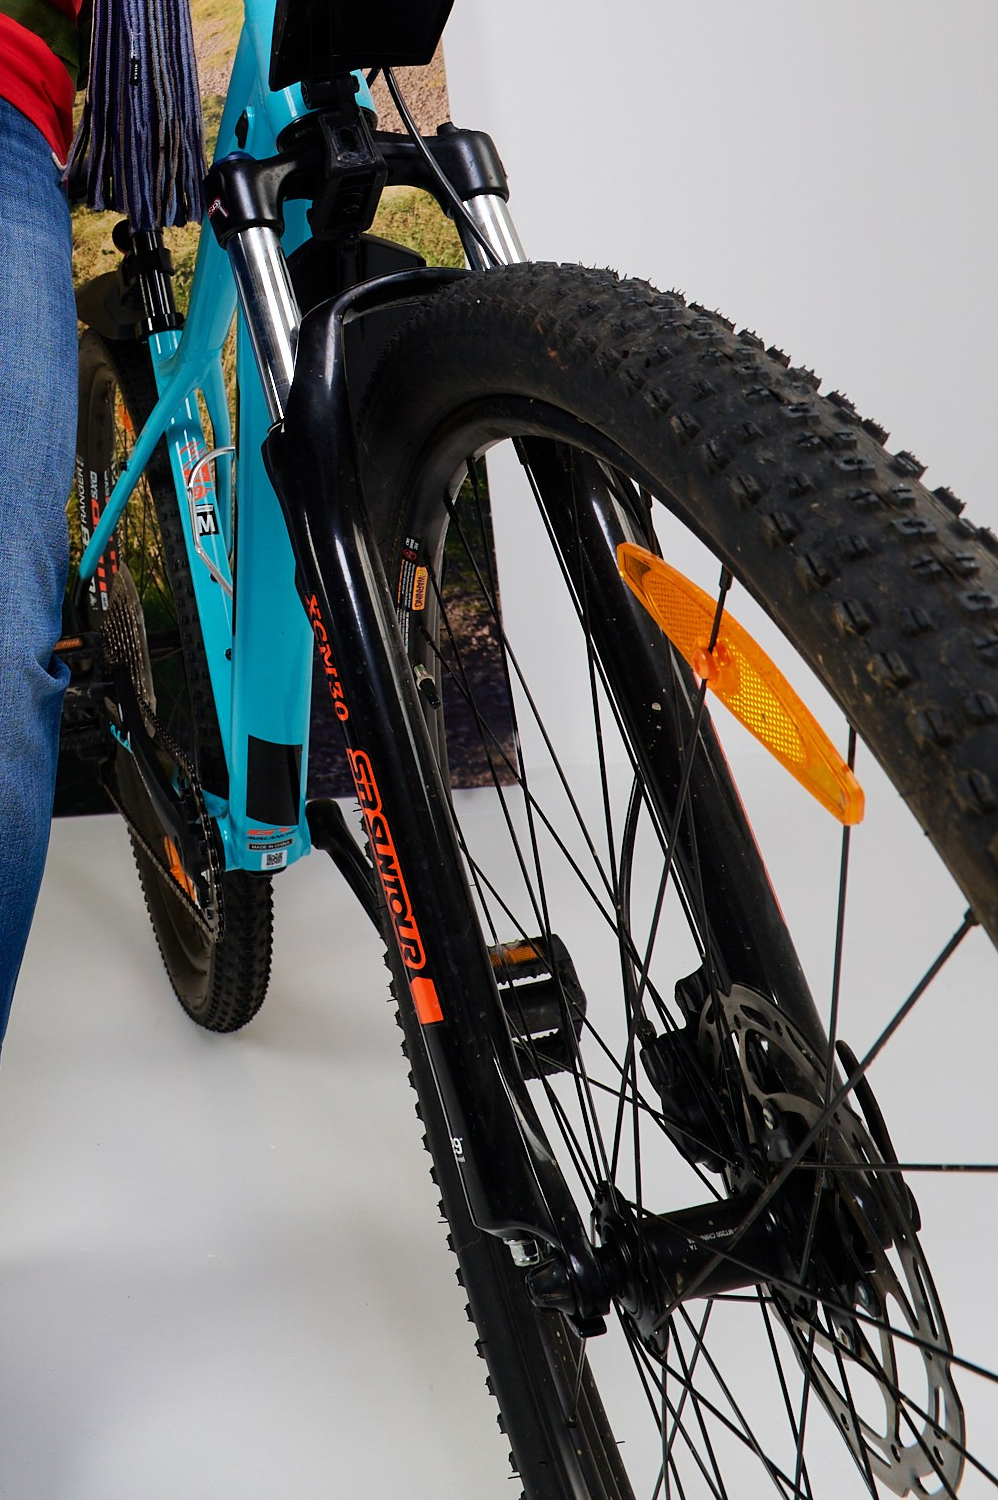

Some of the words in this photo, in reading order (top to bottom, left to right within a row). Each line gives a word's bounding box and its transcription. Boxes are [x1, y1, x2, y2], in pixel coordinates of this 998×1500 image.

[76, 464, 89, 525] RANGER
[197, 514, 217, 534] M
[414, 575, 424, 608] WARNING
[274, 840, 291, 848] CHINA
[369, 813, 425, 968] SUNTOUR
